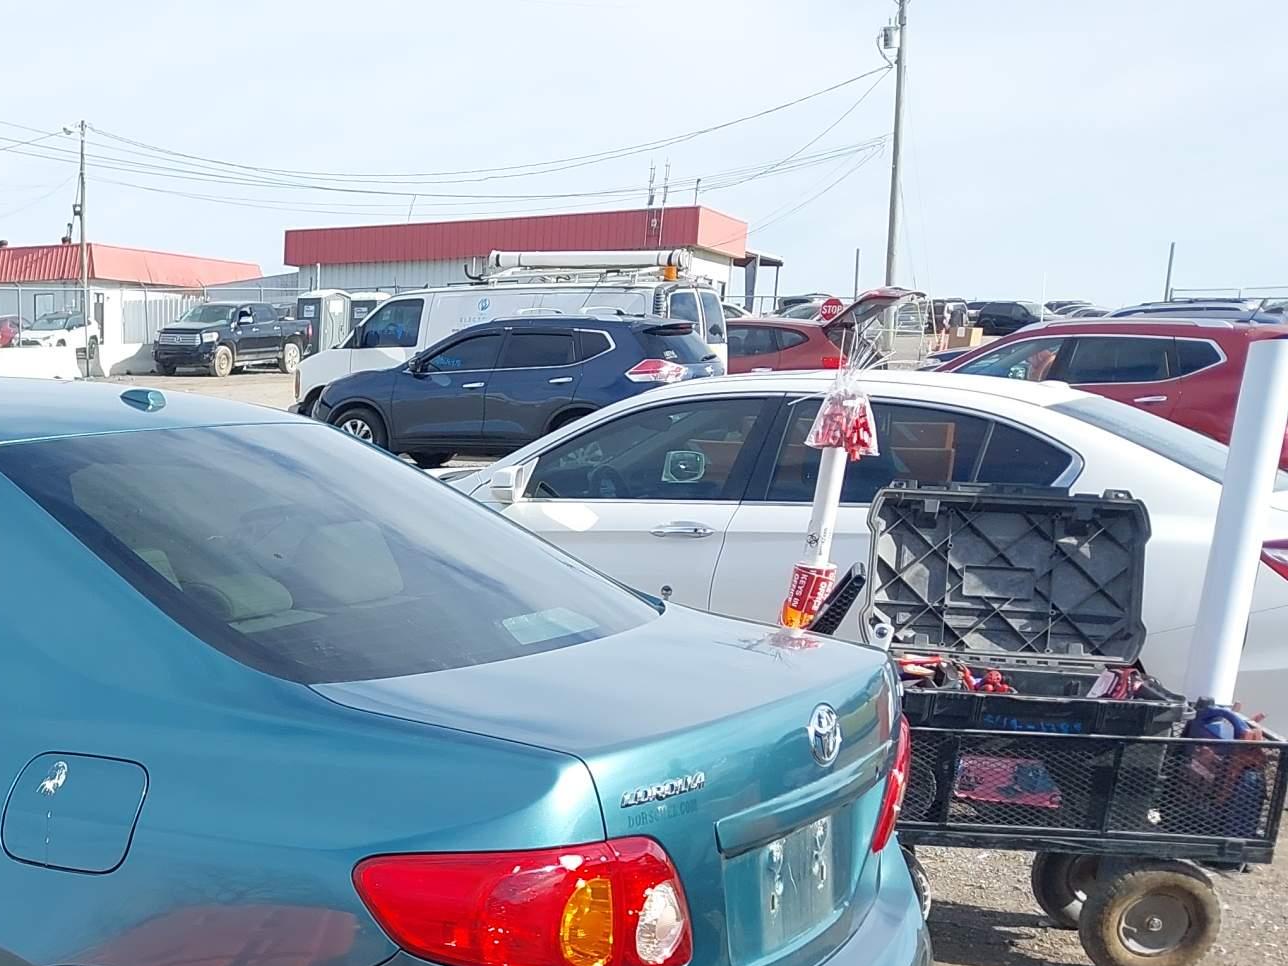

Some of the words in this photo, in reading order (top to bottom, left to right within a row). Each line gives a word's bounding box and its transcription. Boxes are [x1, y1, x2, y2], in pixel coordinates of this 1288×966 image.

[822, 304, 842, 315] STOP
[795, 574, 809, 596] KEYS
[792, 599, 801, 608] IN
